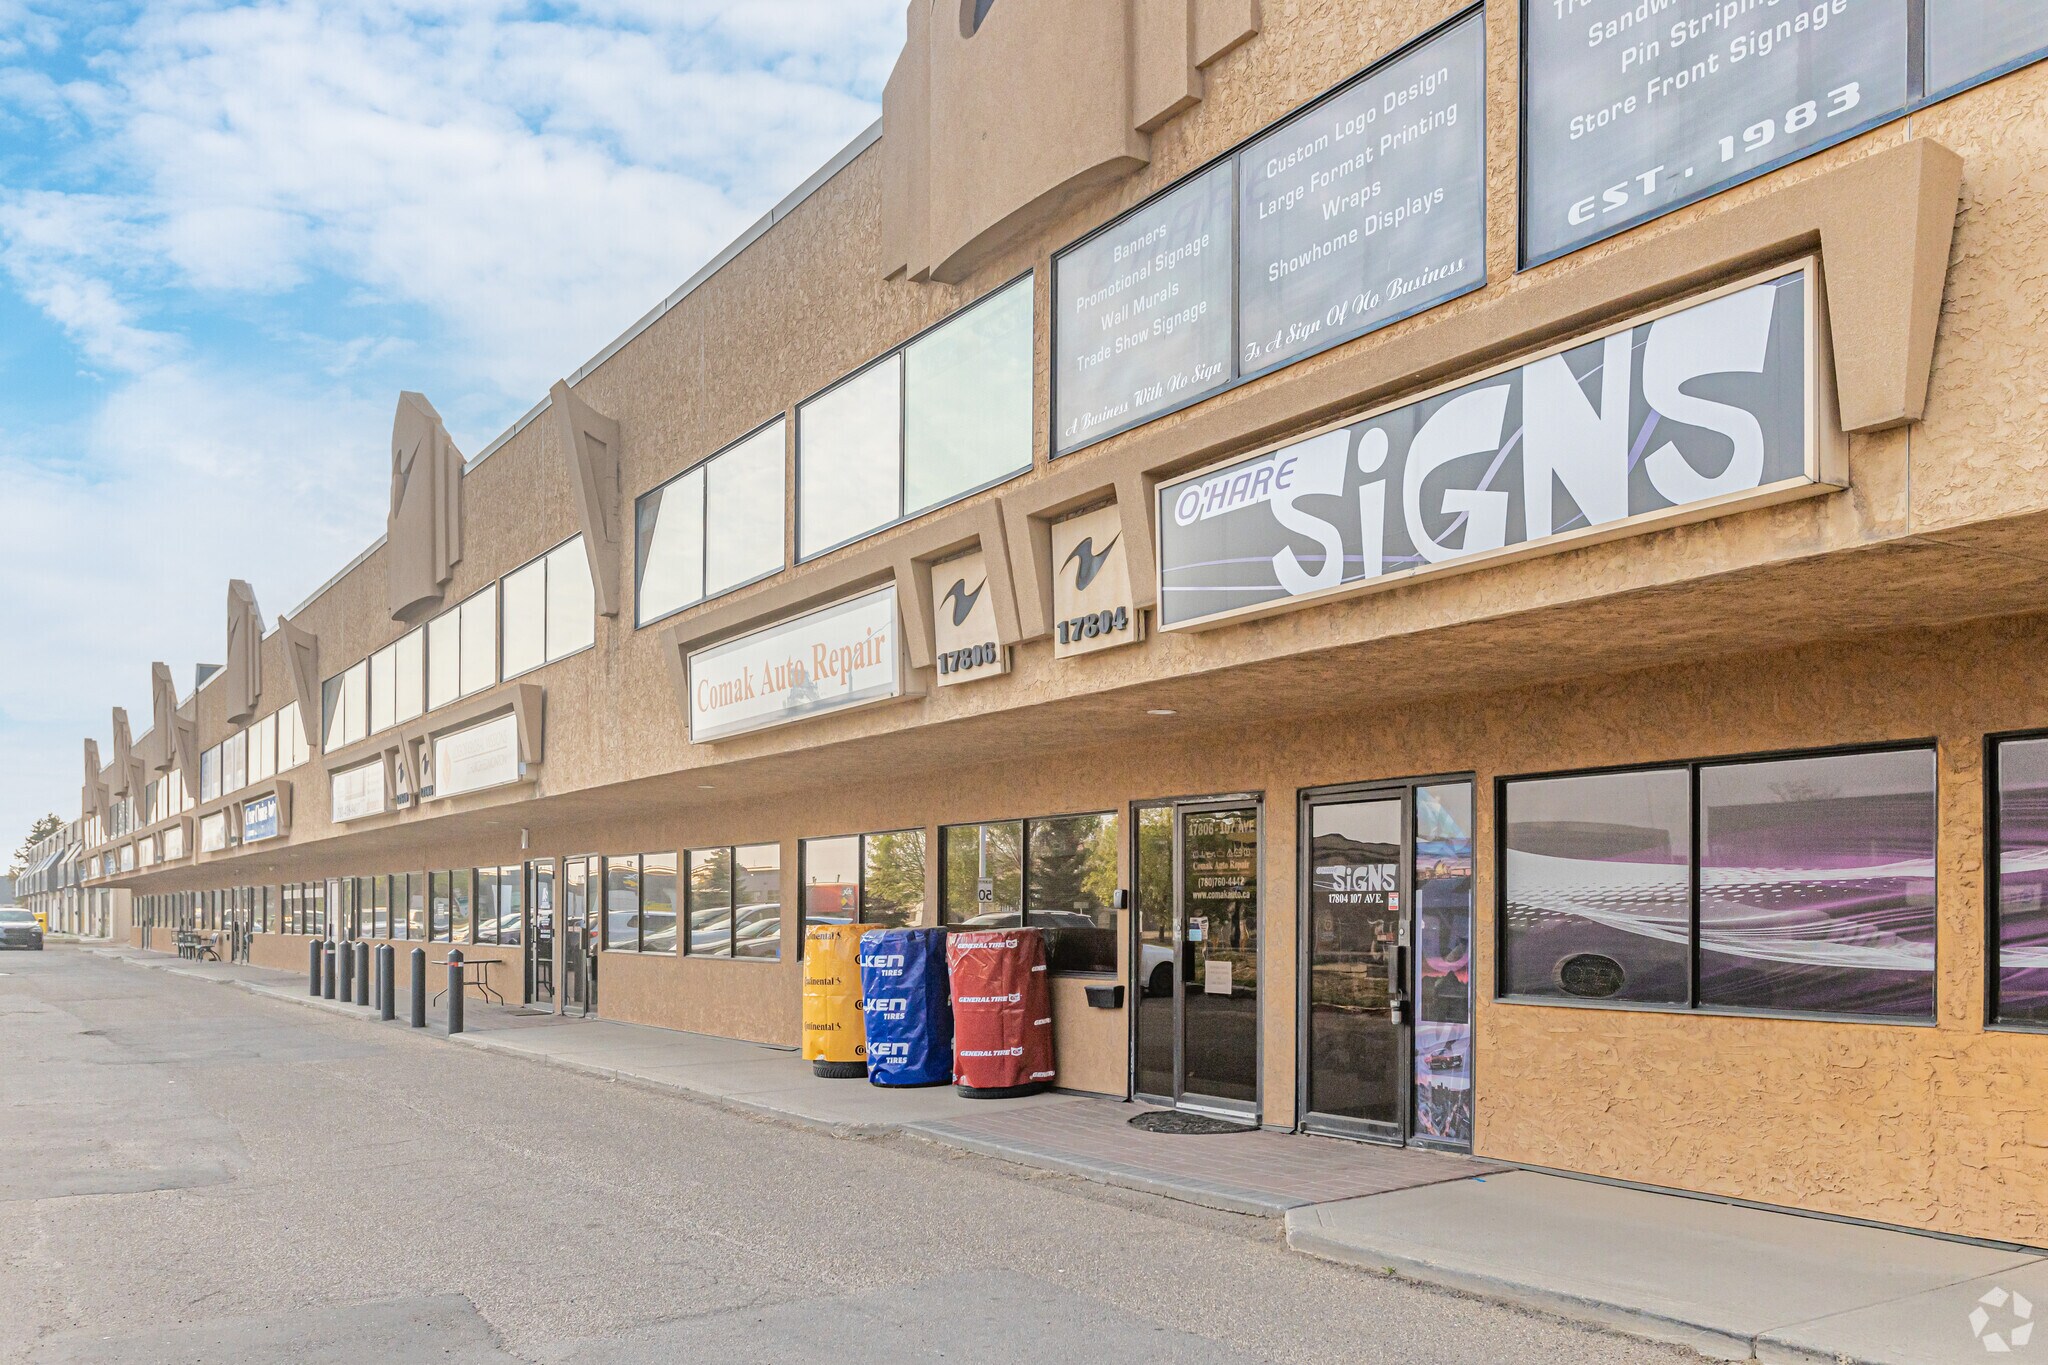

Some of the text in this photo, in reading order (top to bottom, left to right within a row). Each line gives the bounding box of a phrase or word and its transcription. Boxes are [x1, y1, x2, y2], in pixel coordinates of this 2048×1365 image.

[1588, 0, 1677, 47] Sandw
[1569, 0, 1847, 141] Store Front Signage
[1621, 40, 1660, 73] Pin
[1267, 67, 1448, 178] Custom Logo Design
[1718, 81, 1860, 163] 1983
[1259, 104, 1458, 219] Large Format Printing
[1322, 180, 1381, 221] Wraps
[1113, 223, 1167, 262] Banners
[1269, 187, 1445, 282] Showhome Displays
[1076, 233, 1209, 314] Promotional Signage
[1101, 280, 1179, 330] Wall Murals
[1265, 330, 1281, 353] A
[1285, 317, 1321, 344] Sign
[1326, 300, 1348, 326] Of
[1351, 290, 1379, 314] No
[1386, 257, 1465, 301] Business
[1077, 300, 1207, 372] Trade Show Signage
[1065, 362, 1222, 437] A Business With No Sign
[1178, 456, 1298, 520] O'HARE
[1056, 605, 1128, 645] 17804
[697, 626, 886, 713] Comak Auto Repair
[937, 641, 996, 675] 17806
[1188, 822, 1214, 837] 17806
[1192, 860, 1250, 871] Comak Auto Repair
[1192, 889, 1251, 899] www.comakauto.ca
[1328, 893, 1348, 903] 17804
[1350, 893, 1362, 903] 107
[1363, 893, 1384, 903] AVE.
[860, 955, 904, 967] LKEN
[886, 1056, 908, 1064] TIRES
